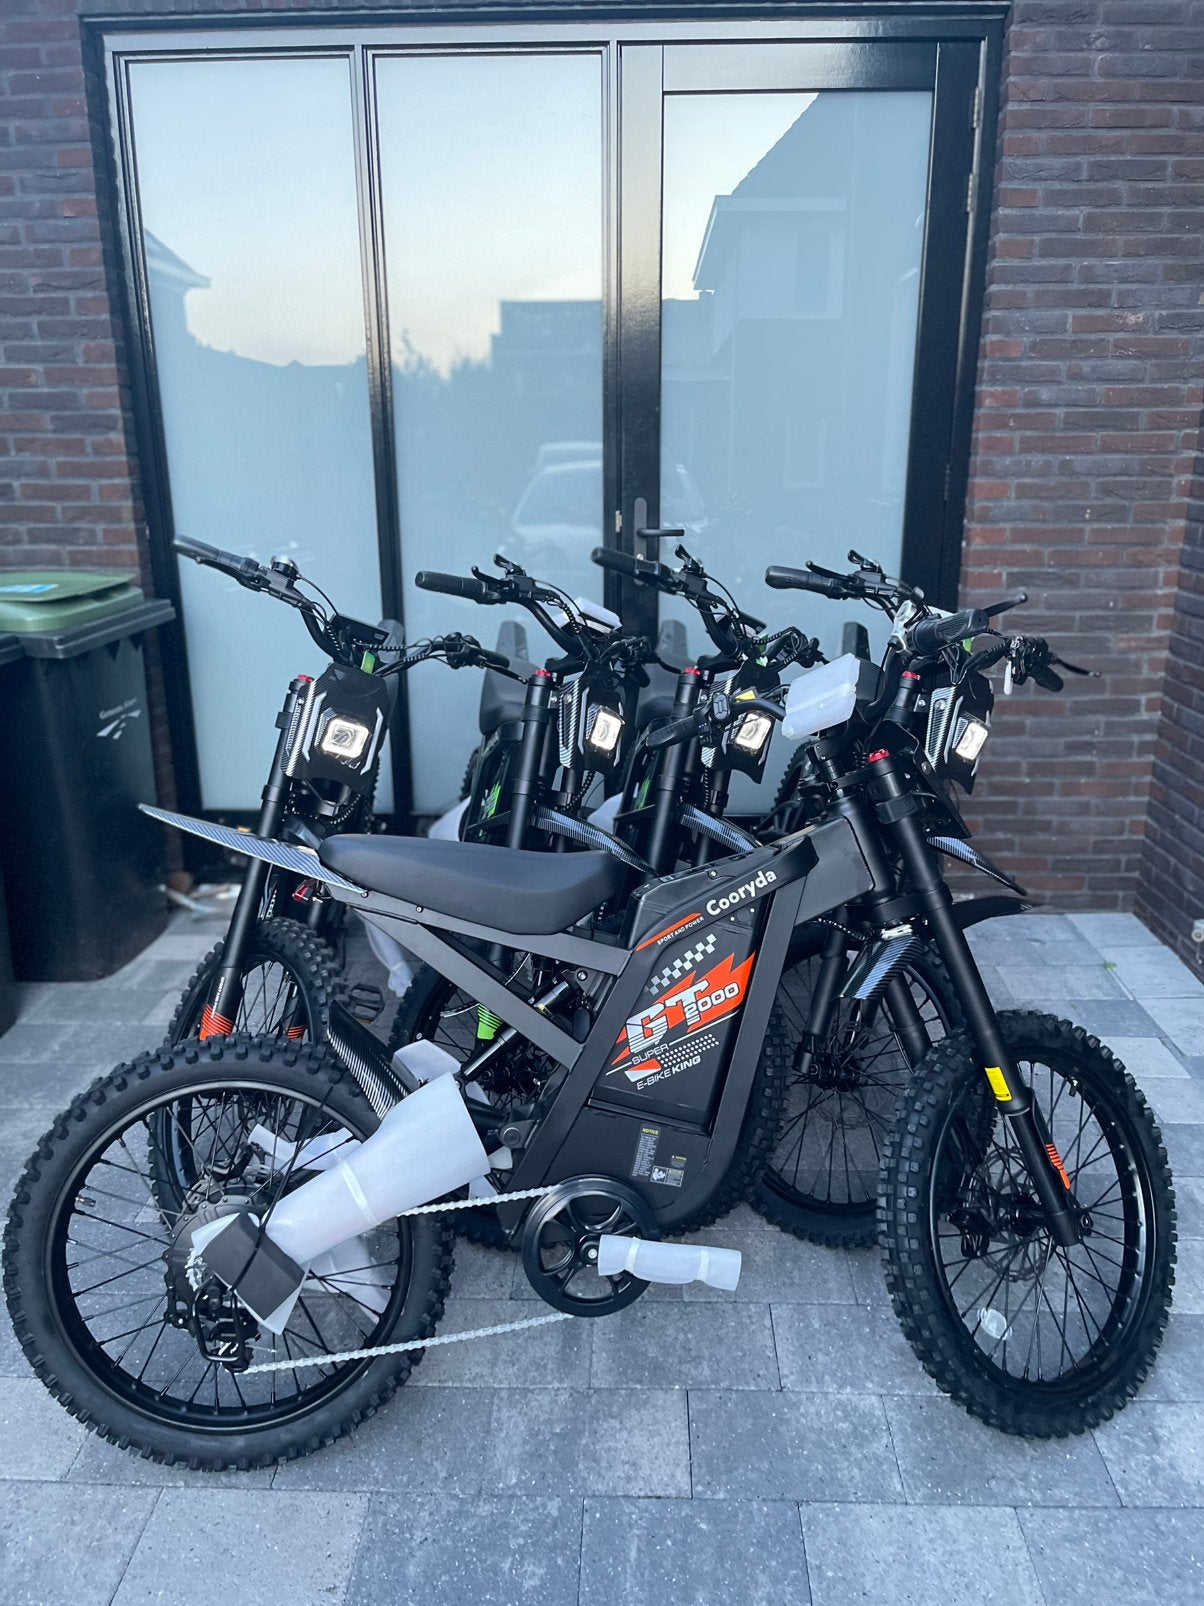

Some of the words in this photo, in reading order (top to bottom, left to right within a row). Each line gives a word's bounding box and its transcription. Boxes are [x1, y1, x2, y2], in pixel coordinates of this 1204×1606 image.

[706, 870, 777, 916] Cooryda
[657, 932, 675, 945] SPORT
[674, 926, 686, 936] AND
[685, 916, 704, 930] POWER
[625, 979, 711, 1054] GT
[683, 982, 739, 1018] 2000
[632, 1043, 669, 1065] SUPER
[636, 1067, 672, 1090] E-BIKE
[671, 1055, 702, 1075] KING
